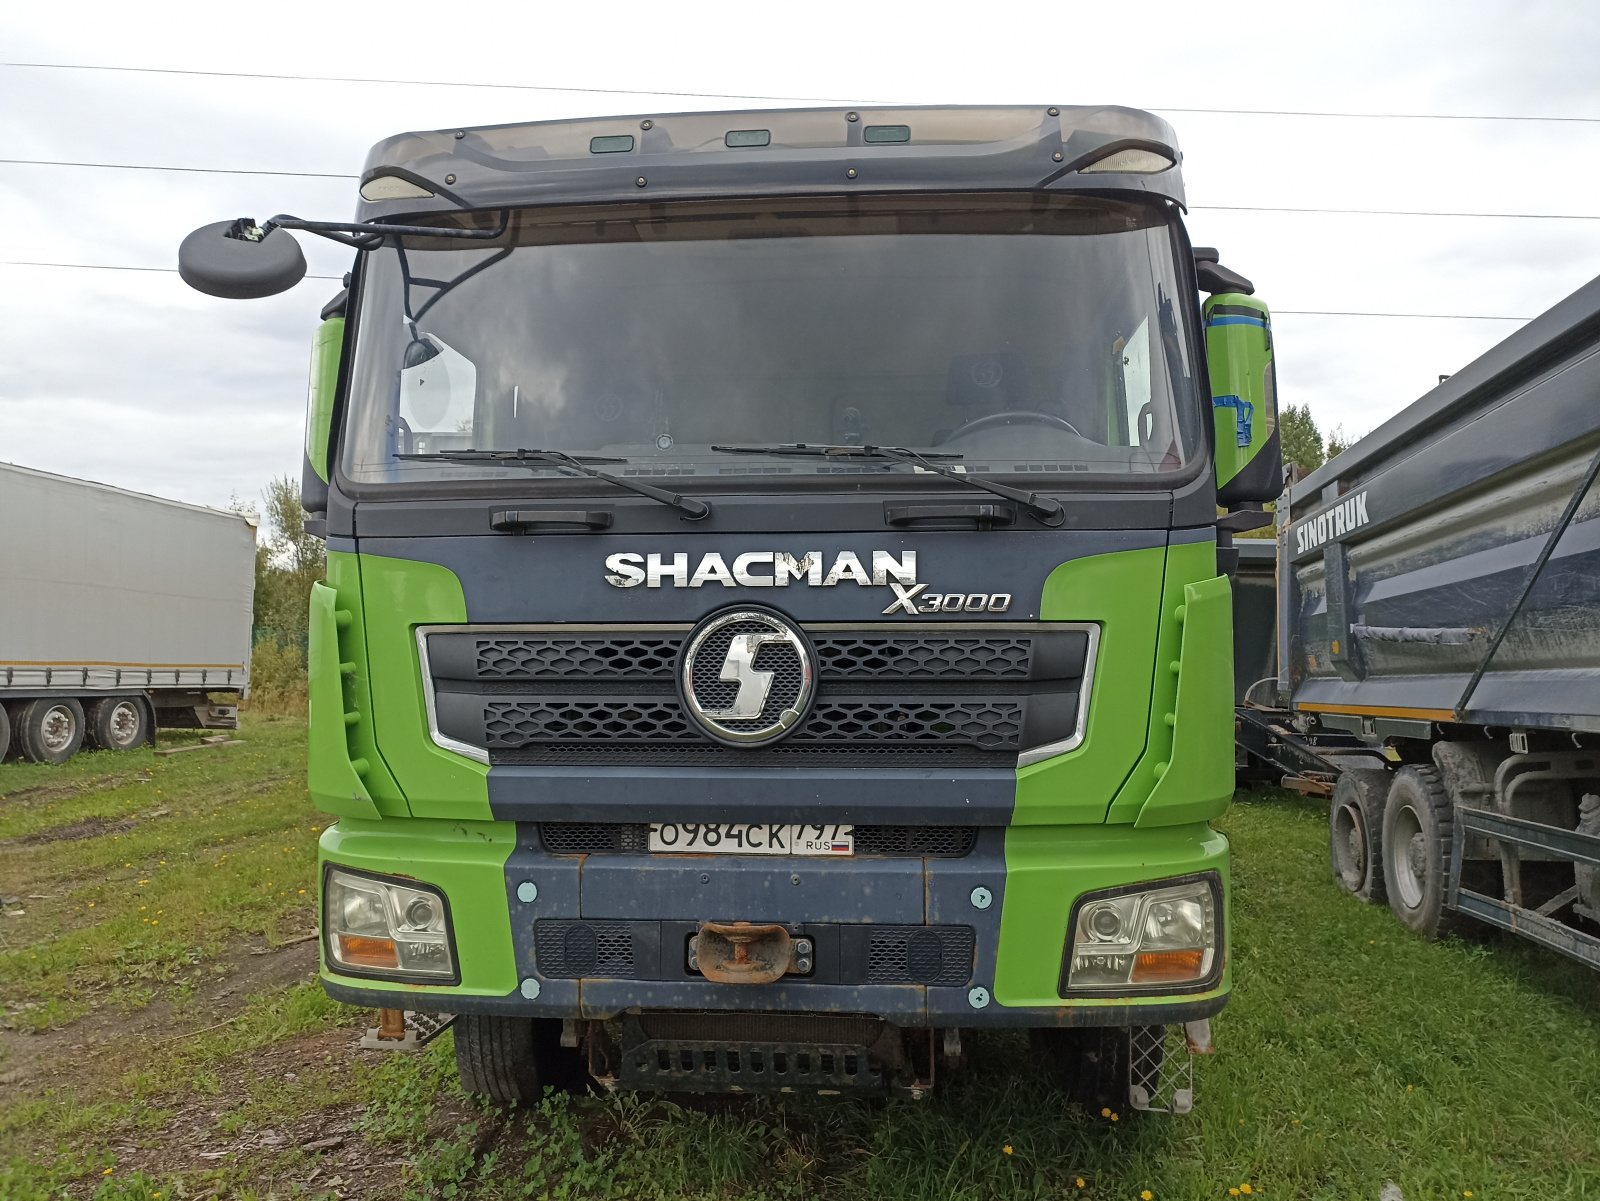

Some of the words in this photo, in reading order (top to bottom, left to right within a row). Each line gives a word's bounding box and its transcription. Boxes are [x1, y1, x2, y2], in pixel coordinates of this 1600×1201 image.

[1296, 490, 1370, 555] SINOTRUK
[603, 550, 917, 588] SHACMAN
[881, 582, 1012, 615] X3000
[805, 840, 831, 851] RUS
